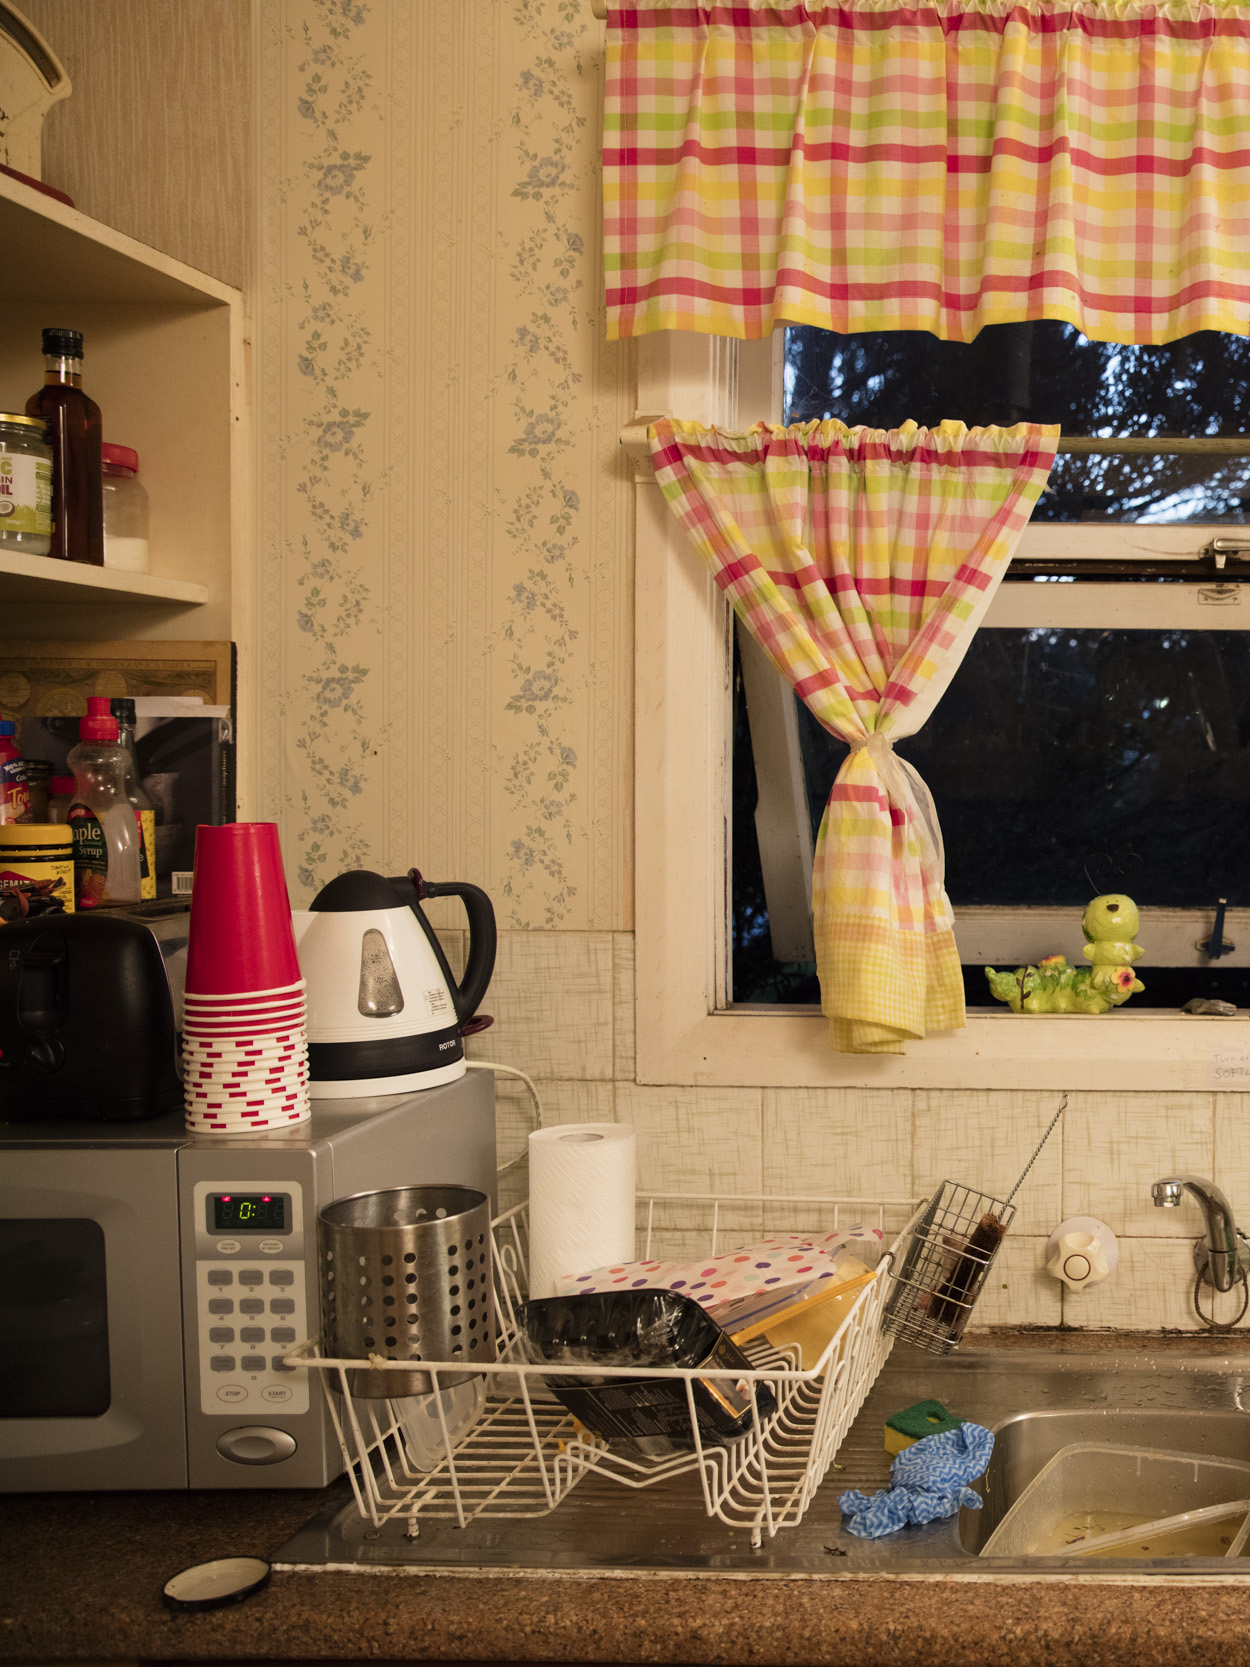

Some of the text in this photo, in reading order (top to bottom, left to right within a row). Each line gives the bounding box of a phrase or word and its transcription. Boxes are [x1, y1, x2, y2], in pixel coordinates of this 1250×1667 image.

[0, 484, 13, 495] IL
[73, 823, 101, 845] aple
[79, 846, 102, 858] Syrup
[438, 1039, 457, 1051] ROTOR
[1213, 1054, 1236, 1063] Turn
